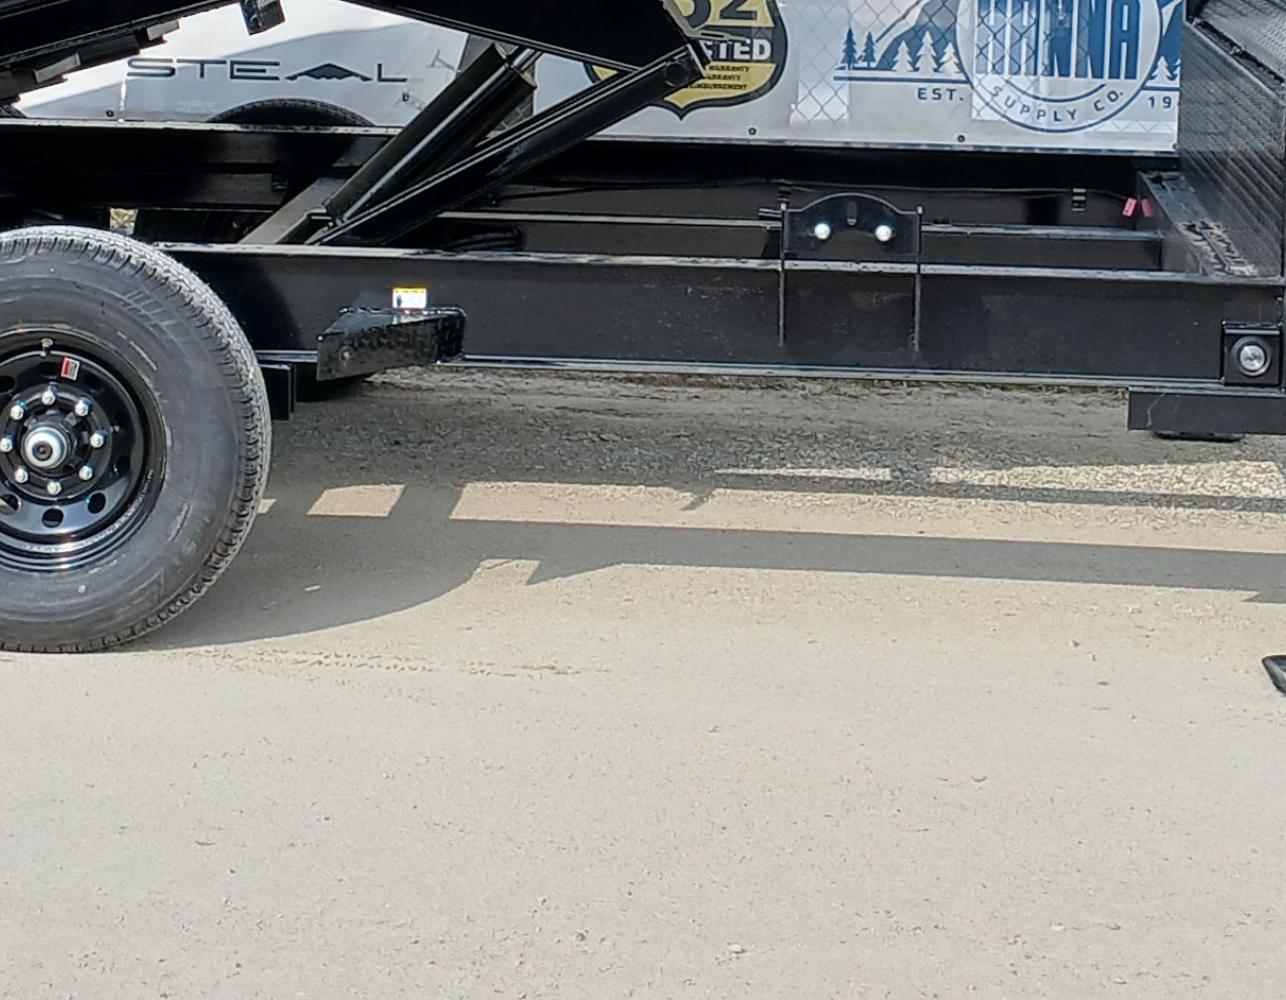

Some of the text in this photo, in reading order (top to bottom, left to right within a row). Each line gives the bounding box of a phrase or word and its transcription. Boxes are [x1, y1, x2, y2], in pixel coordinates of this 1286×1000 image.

[917, 87, 1172, 109] EST. 19
[989, 85, 1124, 122] SUPPLY CO.
